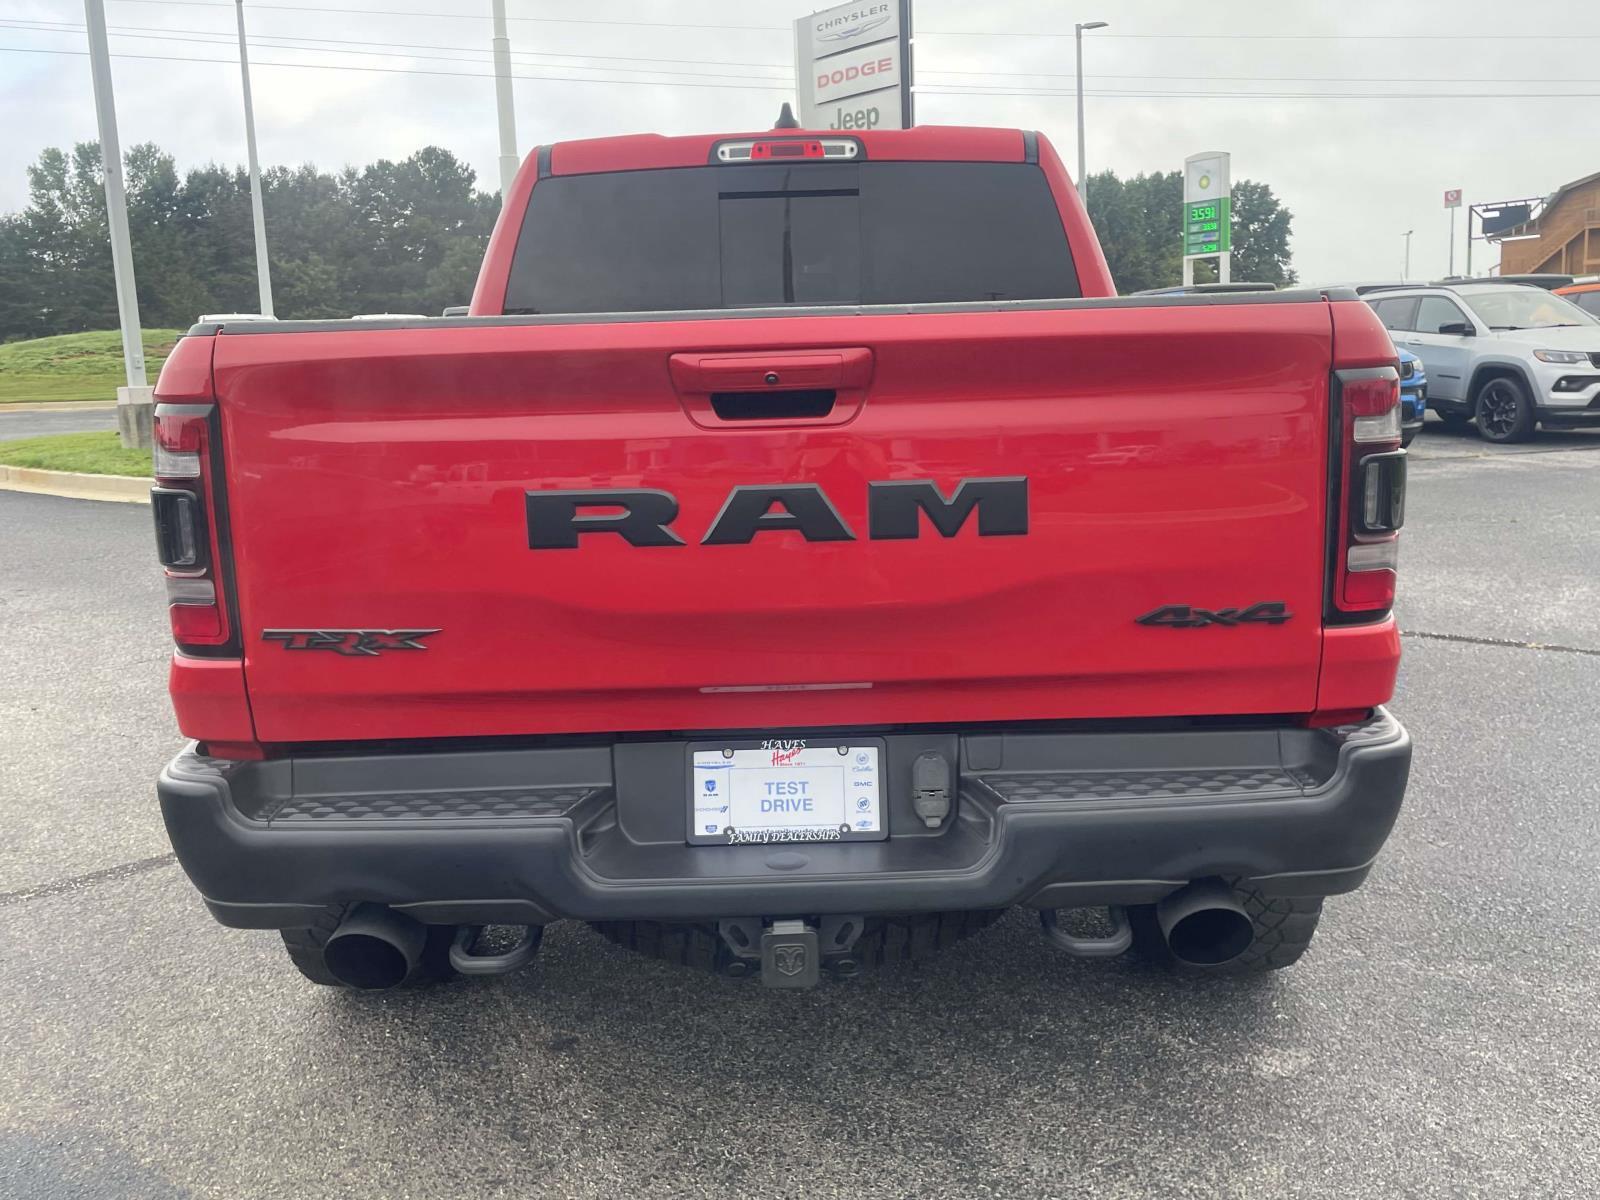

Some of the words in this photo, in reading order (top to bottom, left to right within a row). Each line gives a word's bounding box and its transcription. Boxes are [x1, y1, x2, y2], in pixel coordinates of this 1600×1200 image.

[817, 4, 888, 32] CHRYSLER
[817, 57, 893, 89] DODGE
[830, 106, 880, 130] Jeep
[525, 475, 1029, 550] RAM
[261, 628, 444, 657] TRX
[760, 739, 807, 751] HAYES
[764, 781, 809, 796] TEST
[760, 798, 814, 813] DRIVE
[728, 831, 769, 845] FAMILY
[771, 830, 841, 842] DEALERSHIPS
